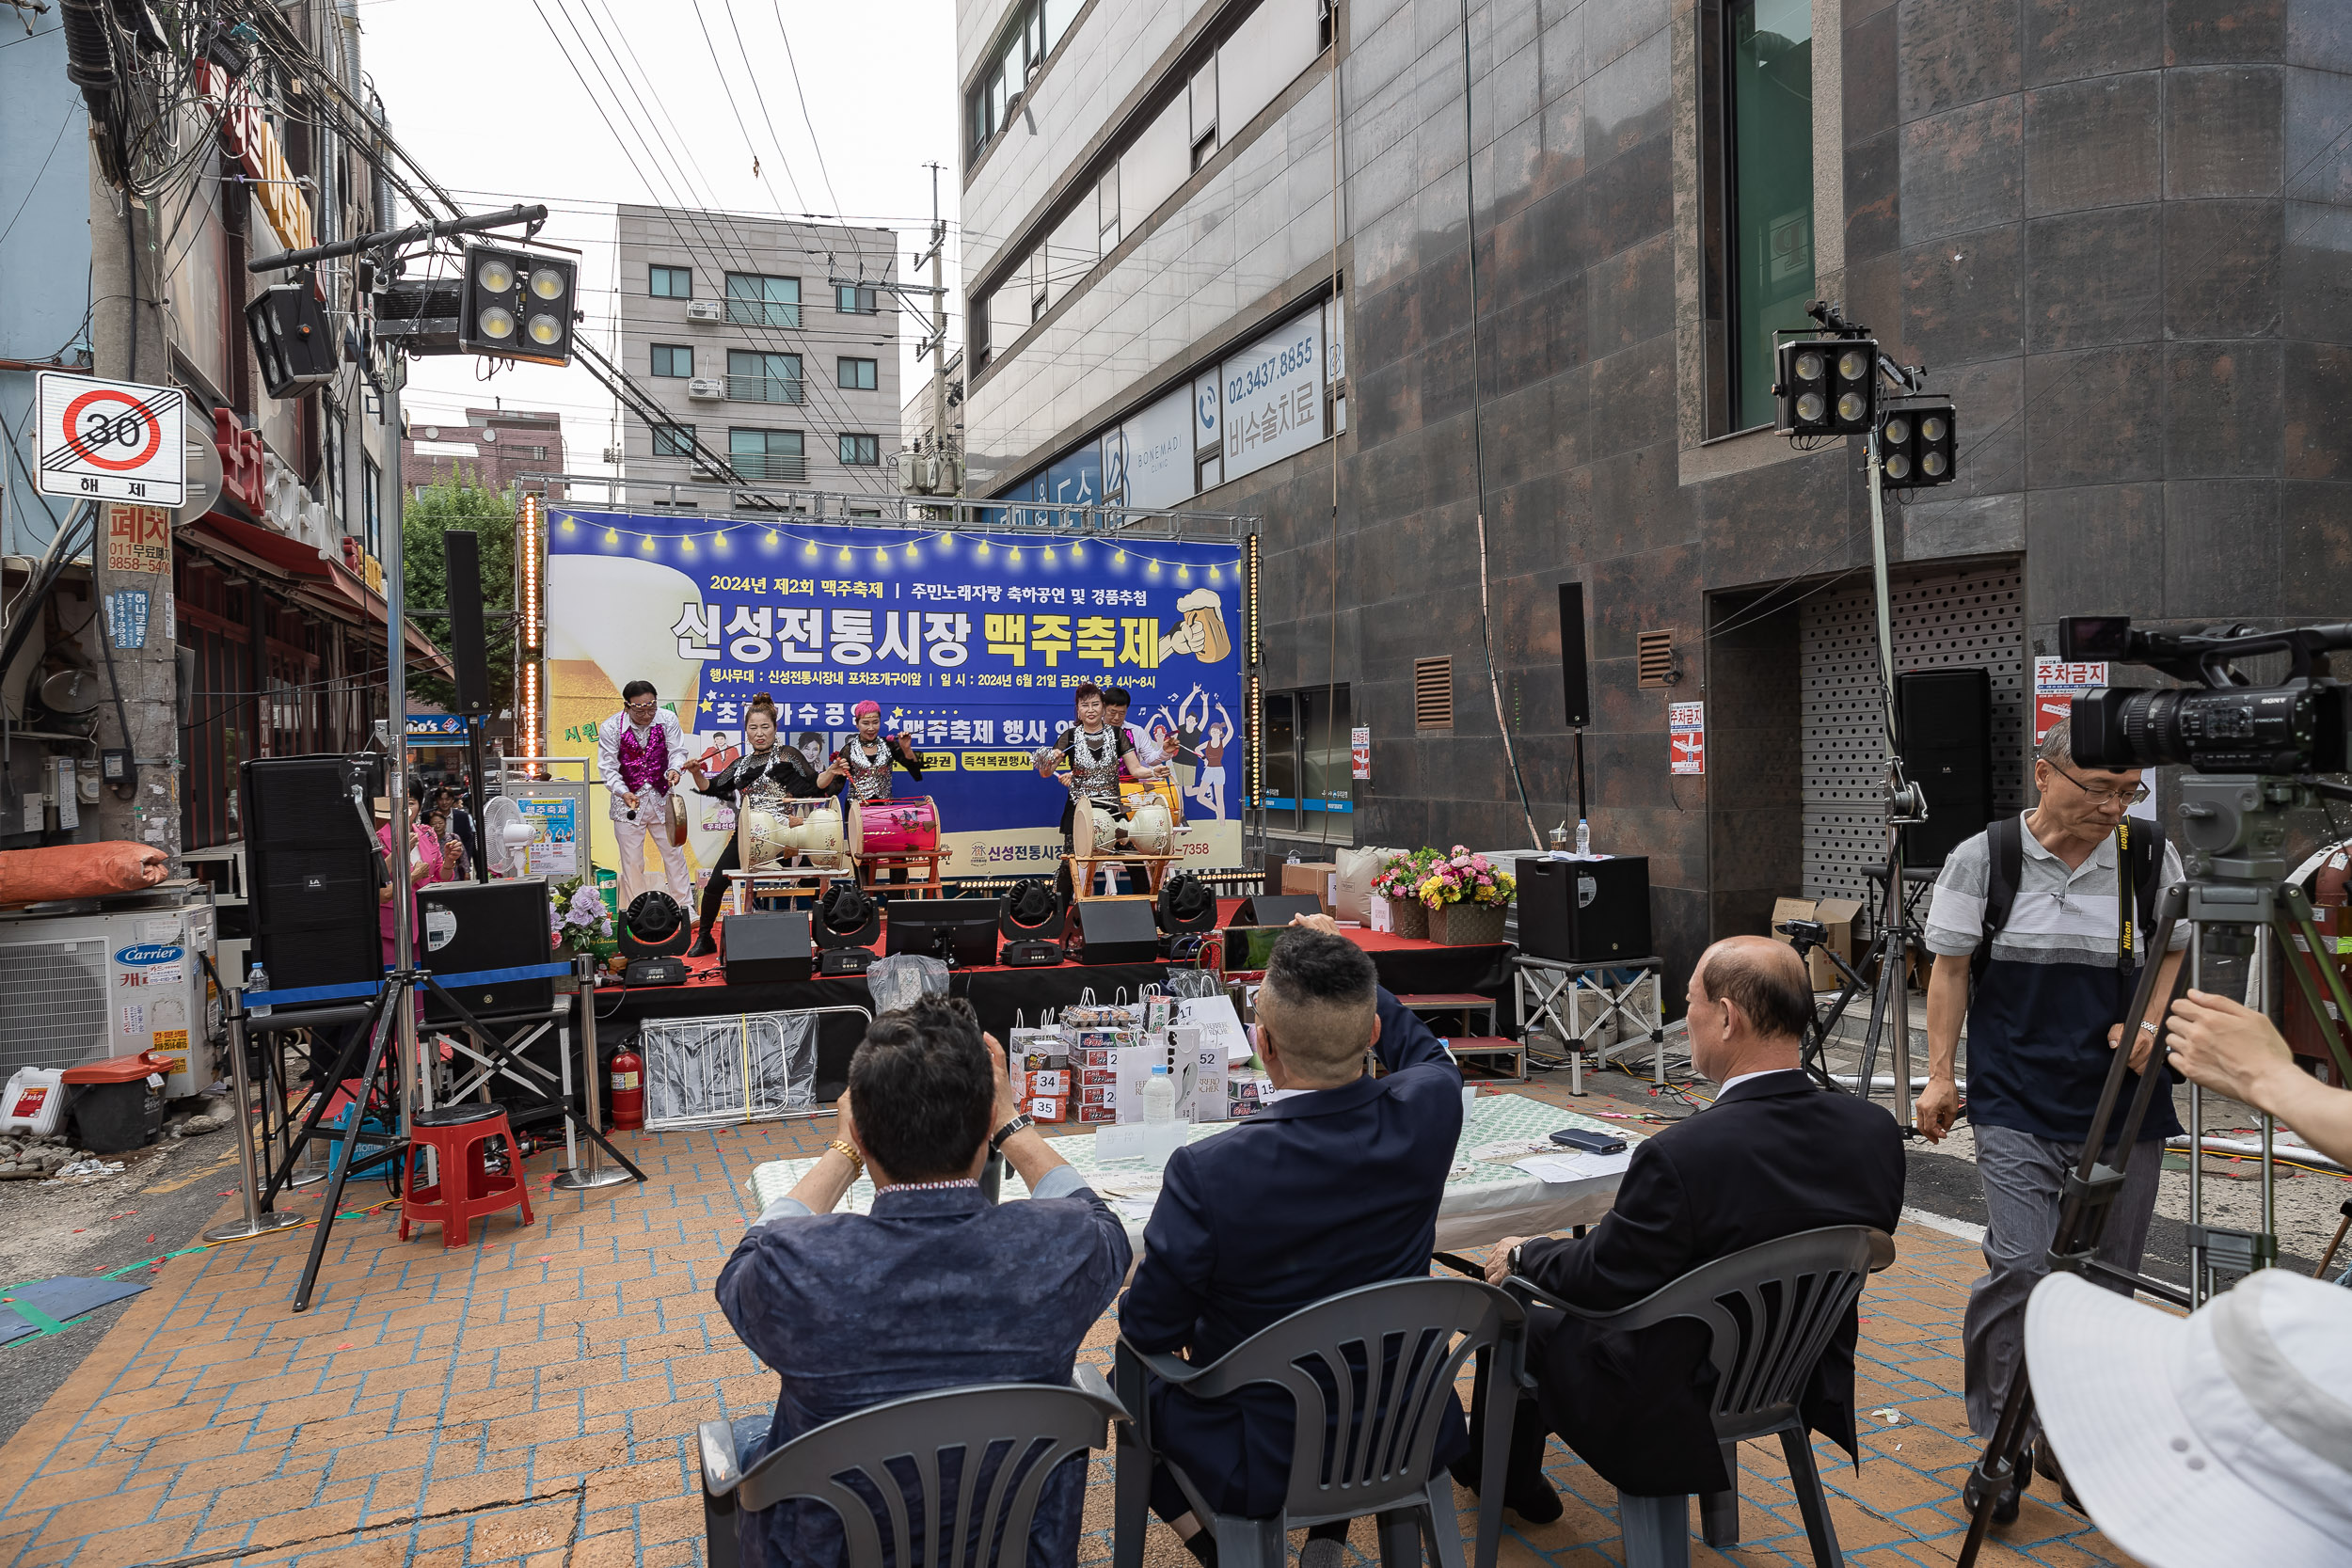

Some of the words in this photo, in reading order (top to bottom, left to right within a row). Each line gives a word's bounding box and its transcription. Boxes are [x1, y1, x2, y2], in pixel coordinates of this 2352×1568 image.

[1229, 337, 1312, 404] 02.3437.8855
[1230, 381, 1315, 458] 비수술치료
[87, 414, 140, 448] 30
[1137, 434, 1182, 467] BONEMADI
[1151, 459, 1168, 473] CLINIC
[110, 508, 170, 548] 폐차
[109, 543, 132, 556] 011
[709, 576, 767, 594] 2024년
[773, 578, 815, 596] 제2회
[820, 580, 883, 599] 맥주축제
[911, 583, 1002, 603] 주민노래자랑
[1007, 586, 1065, 605] 축하공연
[1071, 588, 1086, 605] 및
[1091, 589, 1148, 607] 경품추첨
[670, 602, 973, 668] 신성전통시장
[984, 612, 1160, 669] 맥주축제
[709, 668, 755, 684] 행사무대
[768, 670, 844, 686] 신성전통시장내
[848, 672, 922, 687] 포차조개구이앞
[977, 674, 1012, 688] 2024년
[1015, 674, 1033, 688] 6월
[1036, 674, 1057, 688] 21일
[1094, 675, 1114, 688] 오후
[1116, 676, 1156, 689] 4시~8시
[2037, 663, 2106, 685] 주차금지
[1670, 708, 1702, 725] 주차금지
[1003, 720, 1047, 744] 행사
[963, 755, 1030, 768] 즉석복권행사
[525, 805, 567, 815] 맥주축제
[2118, 824, 2129, 850] Nikon
[988, 846, 1064, 862] 신성전통시장
[2122, 921, 2132, 950] Nikon
[124, 948, 176, 961] Carrier
[1179, 1006, 1192, 1019] 17
[1200, 1053, 1216, 1065] 52
[1040, 1076, 1055, 1087] 34
[1262, 1084, 1276, 1095] 15
[1037, 1101, 1053, 1113] 35
